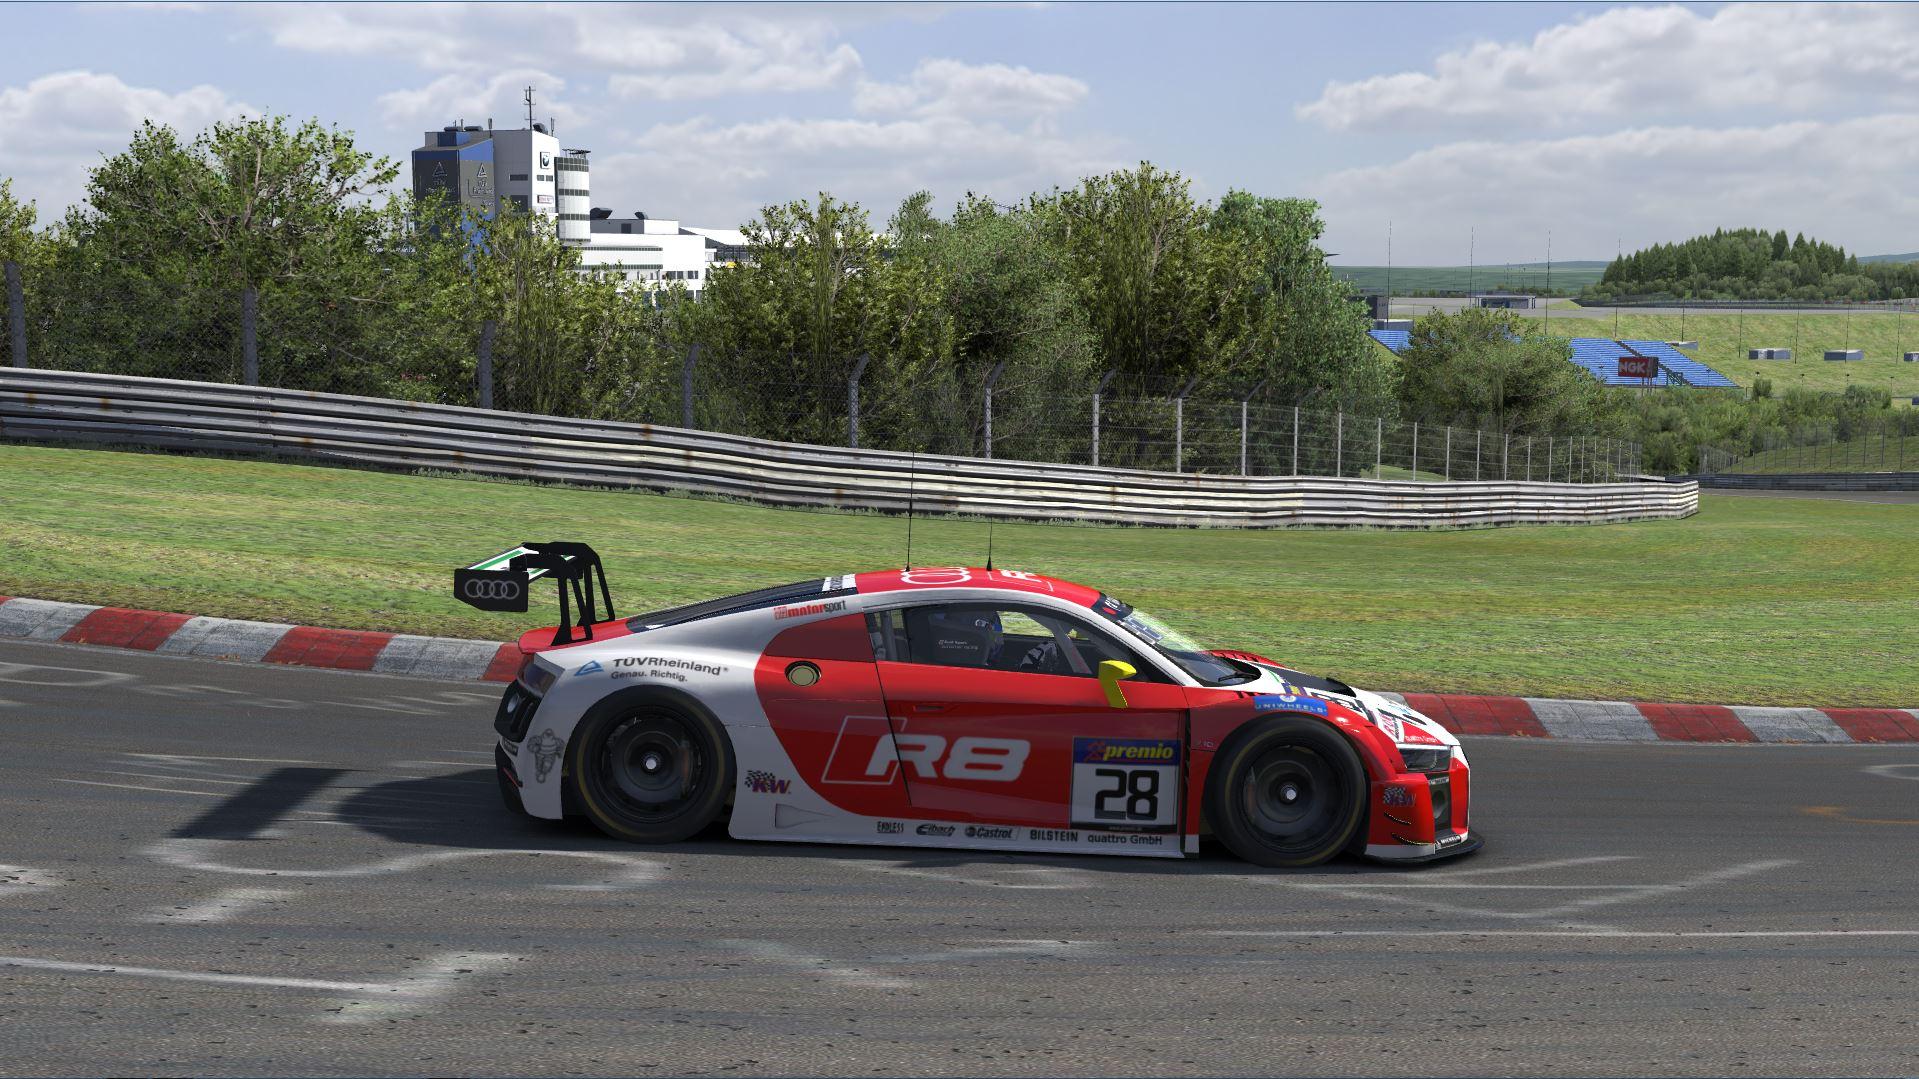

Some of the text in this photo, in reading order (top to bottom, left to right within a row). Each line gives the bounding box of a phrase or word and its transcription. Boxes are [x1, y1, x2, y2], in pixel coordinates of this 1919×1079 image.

[1619, 361, 1646, 374] NGK
[610, 669, 689, 682] Genau. Richtig.
[865, 732, 1031, 782] R8
[1103, 742, 1174, 761] premio
[752, 778, 792, 794] KW
[1094, 768, 1160, 821] 28
[876, 820, 905, 834] ENDLESS
[976, 826, 1013, 839] Castrol
[1029, 829, 1079, 843] BILSTEIN
[1087, 833, 1163, 846] quattro GmbH
